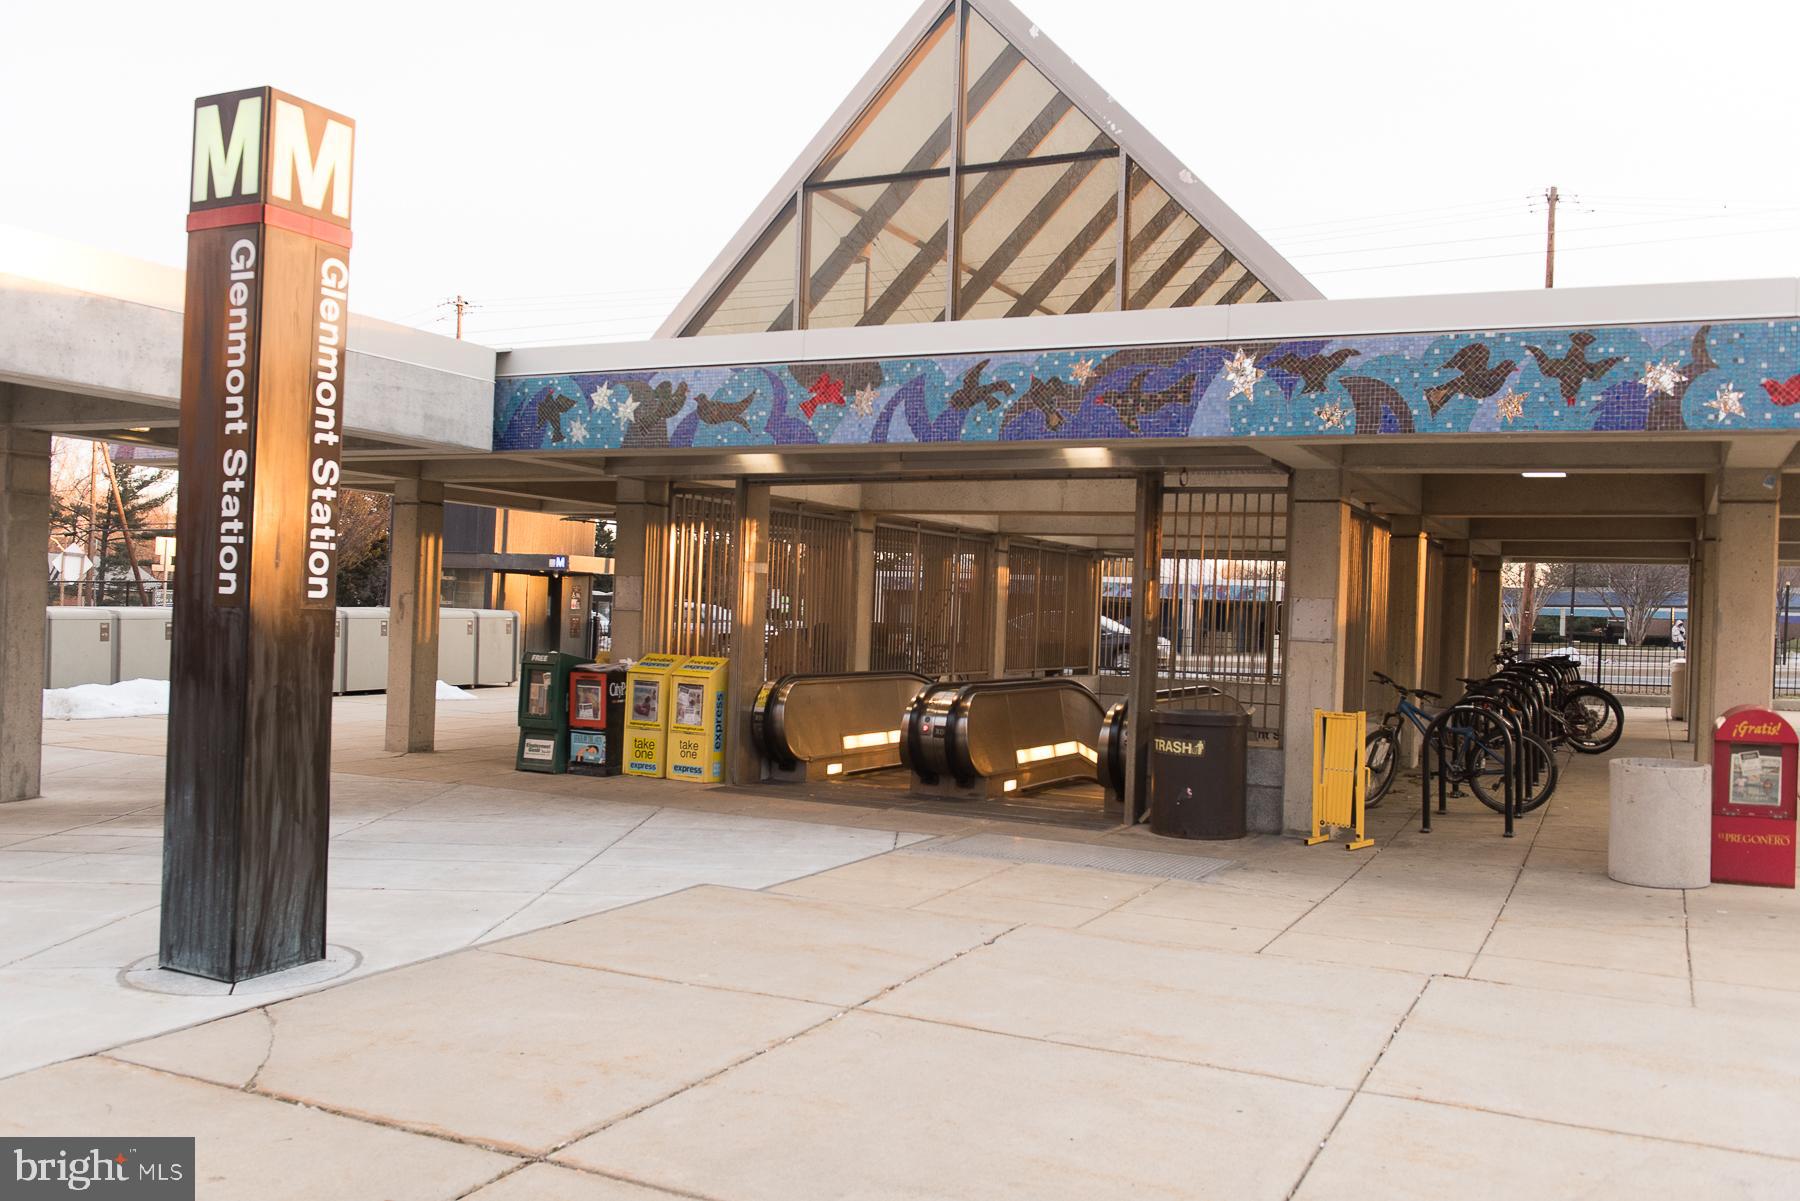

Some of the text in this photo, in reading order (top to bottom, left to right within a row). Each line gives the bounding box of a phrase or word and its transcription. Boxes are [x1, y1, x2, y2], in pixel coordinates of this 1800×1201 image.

[192, 96, 262, 203] M
[271, 99, 353, 219] M
[218, 239, 256, 595] Glenmont Station
[307, 257, 348, 599] Glenmont Station
[555, 556, 566, 568] M
[531, 654, 549, 662] FREE
[714, 690, 724, 750] express
[1732, 720, 1781, 737] ¡Gratis!
[634, 737, 655, 750] take
[679, 740, 699, 751] take
[1154, 738, 1192, 754] TRASH
[634, 749, 654, 759] one
[680, 750, 697, 759] one
[630, 762, 656, 771] express
[673, 764, 702, 774] express
[1725, 832, 1791, 846] PREGONERO
